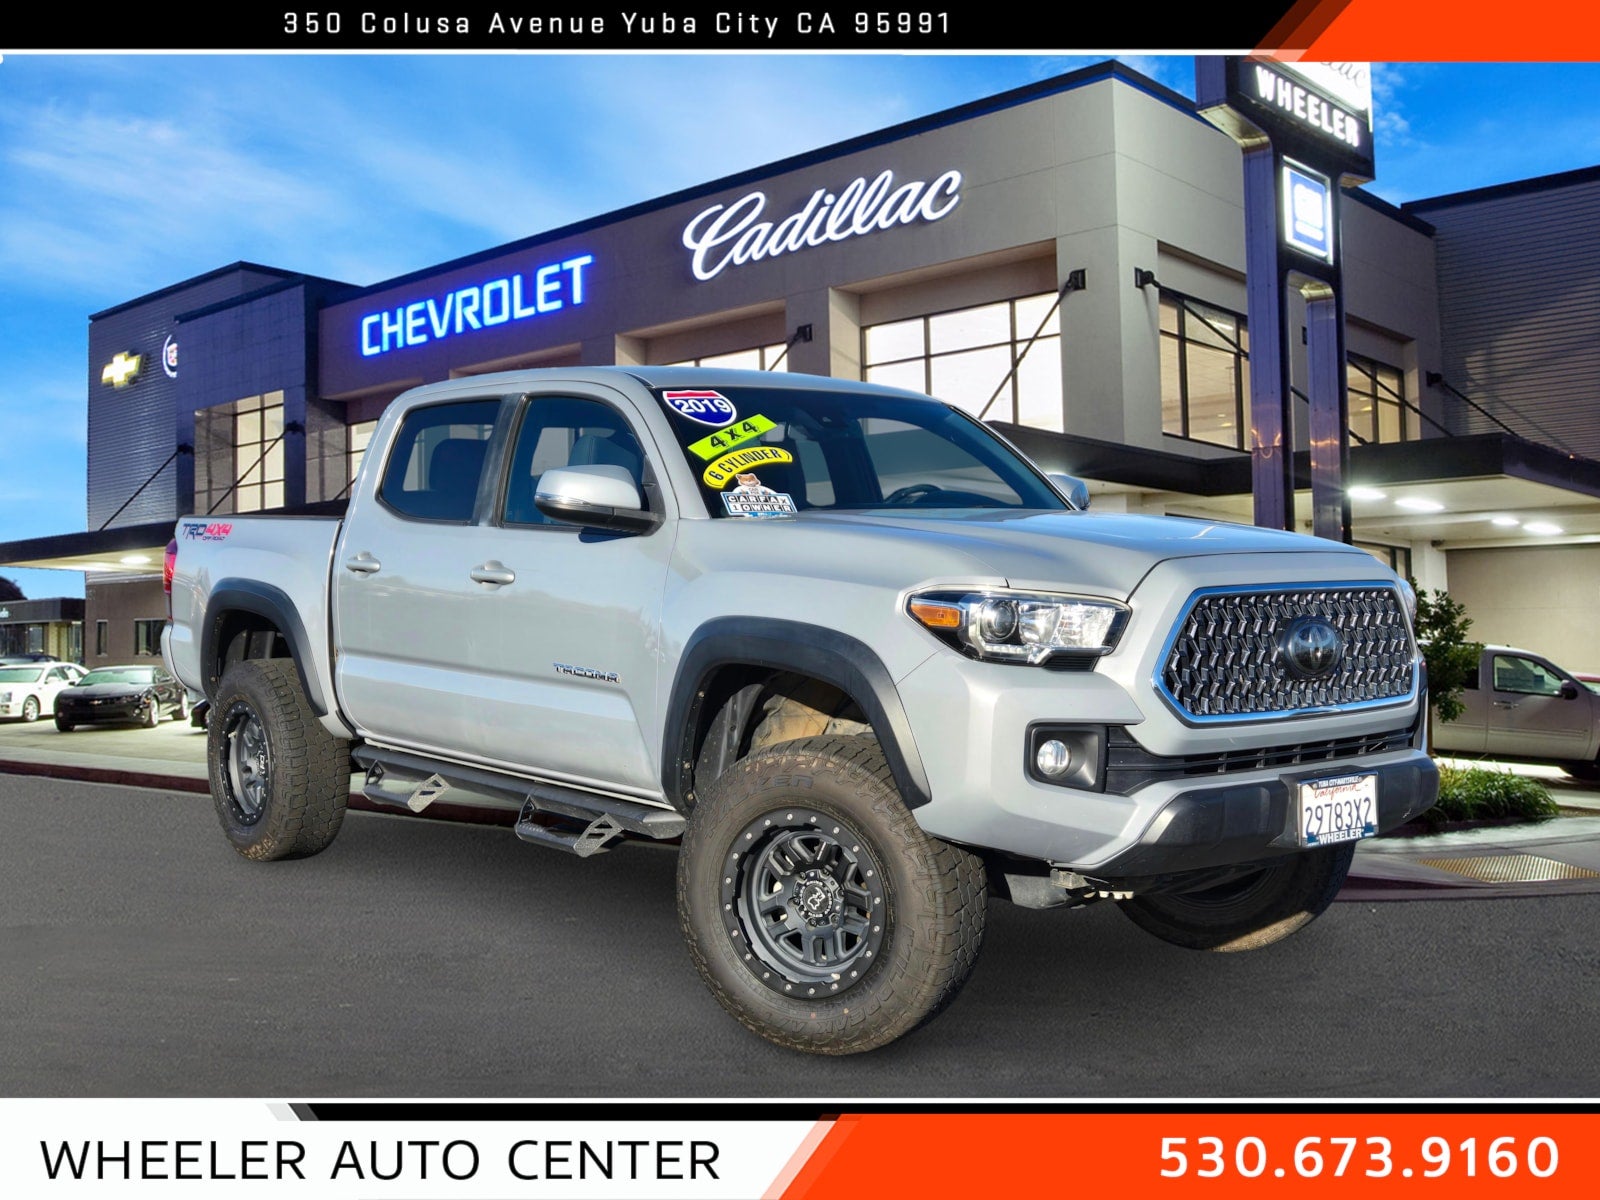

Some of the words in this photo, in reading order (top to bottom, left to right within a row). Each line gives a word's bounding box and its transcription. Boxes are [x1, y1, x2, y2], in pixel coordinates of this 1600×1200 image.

[1255, 65, 1361, 148] WHEELER
[682, 168, 963, 282] Cadillac
[360, 254, 594, 357] CHEVROLET
[674, 398, 732, 413] 2019
[708, 470, 725, 481] 6
[718, 448, 782, 473] CYLINDER
[728, 495, 788, 505] CARFAX
[742, 504, 792, 512] OWNER
[553, 662, 621, 683] TACOMA
[1314, 783, 1358, 800] California
[1305, 796, 1372, 837] 29783X2
[1319, 827, 1363, 845] WHEELER
